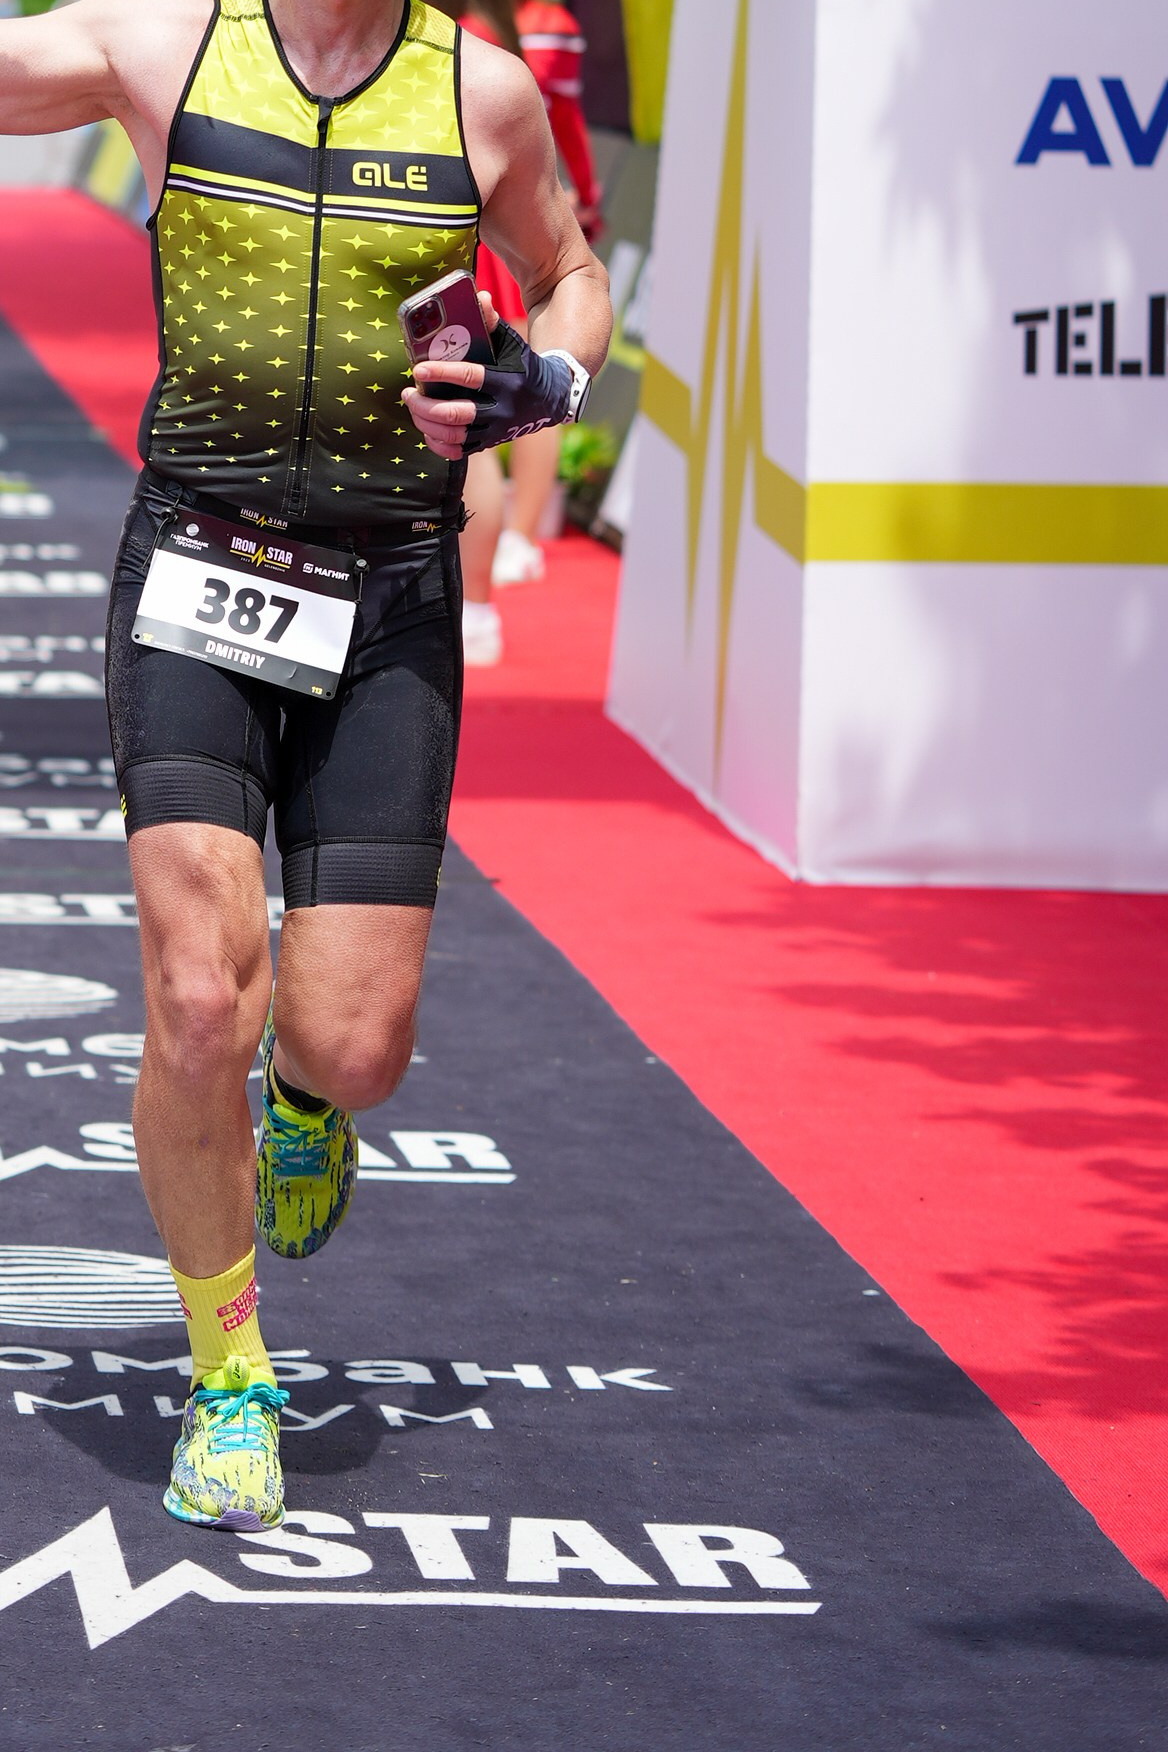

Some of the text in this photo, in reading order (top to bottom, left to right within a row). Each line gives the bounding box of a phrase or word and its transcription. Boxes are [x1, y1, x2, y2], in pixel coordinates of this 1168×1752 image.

[412, 521, 428, 530] IRON
[231, 536, 293, 565] IRON STAR
[313, 566, 350, 581] МАГНИТ
[195, 577, 300, 644] 387
[205, 639, 266, 669] DMITRIY
[236, 1508, 812, 1590] STAR
